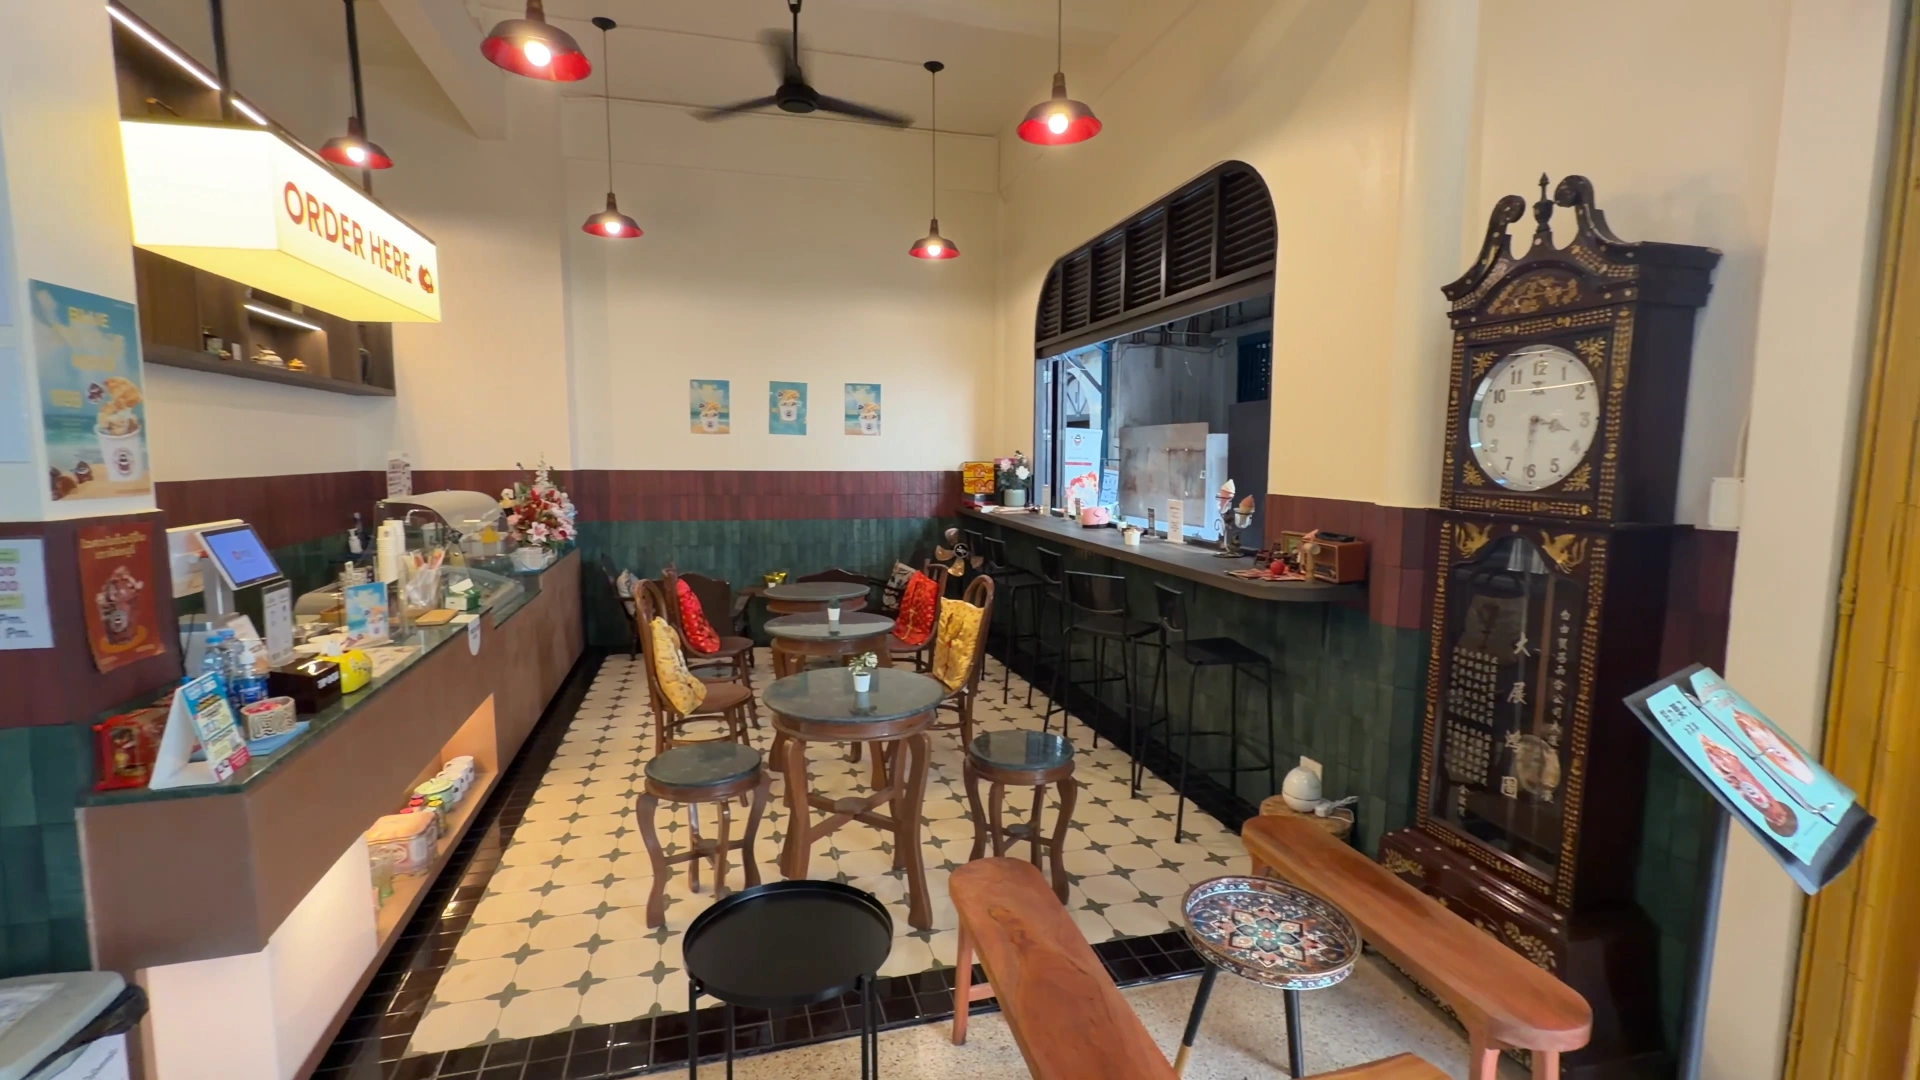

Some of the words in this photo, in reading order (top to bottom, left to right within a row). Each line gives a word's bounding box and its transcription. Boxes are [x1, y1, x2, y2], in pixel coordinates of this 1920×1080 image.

[283, 181, 366, 260] ORDER
[369, 231, 413, 285] HERE
[1533, 361, 1548, 376] 12
[1561, 367, 1567, 381] 1
[1511, 370, 1522, 385] 11
[1494, 389, 1506, 403] 10
[1575, 384, 1586, 400] 2
[1486, 414, 1496, 428] 9
[1579, 412, 1590, 428] 3
[1570, 440, 1581, 454] 4
[1505, 457, 1514, 471] 7
[1526, 464, 1536, 478] 6
[1550, 458, 1560, 473] 5
